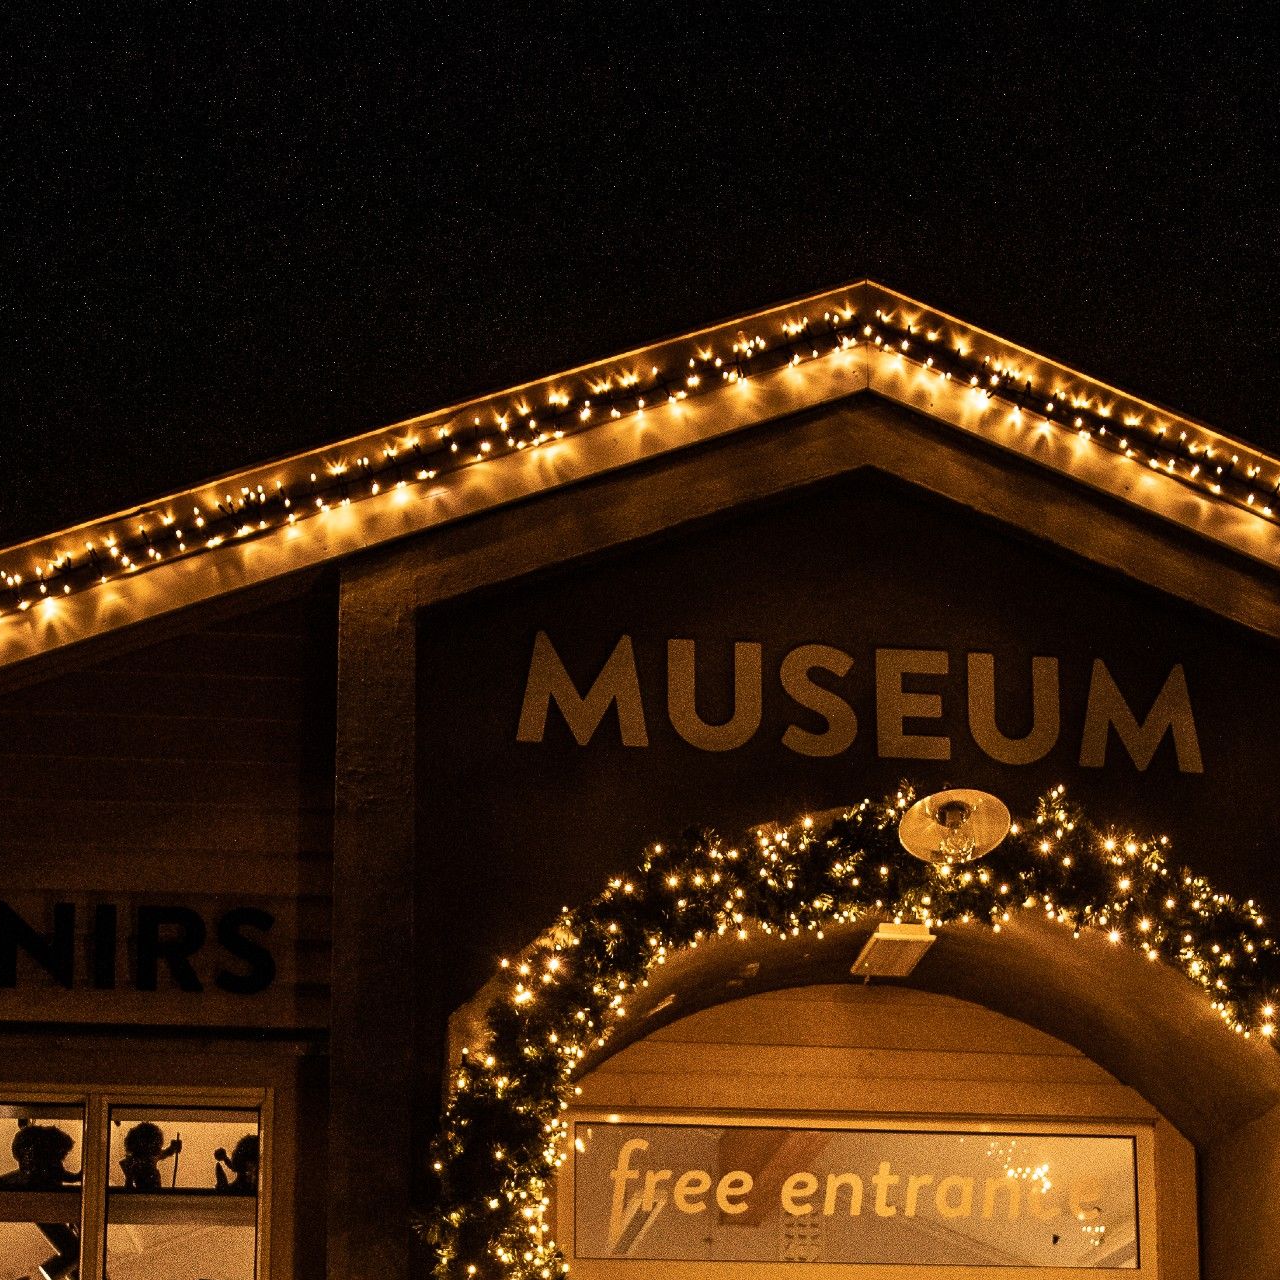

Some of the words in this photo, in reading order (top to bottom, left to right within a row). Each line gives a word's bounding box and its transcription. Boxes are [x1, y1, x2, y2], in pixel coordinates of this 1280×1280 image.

[515, 630, 1204, 774] MUSEUM
[609, 1138, 755, 1248] free
[781, 1160, 1102, 1221] entrance
